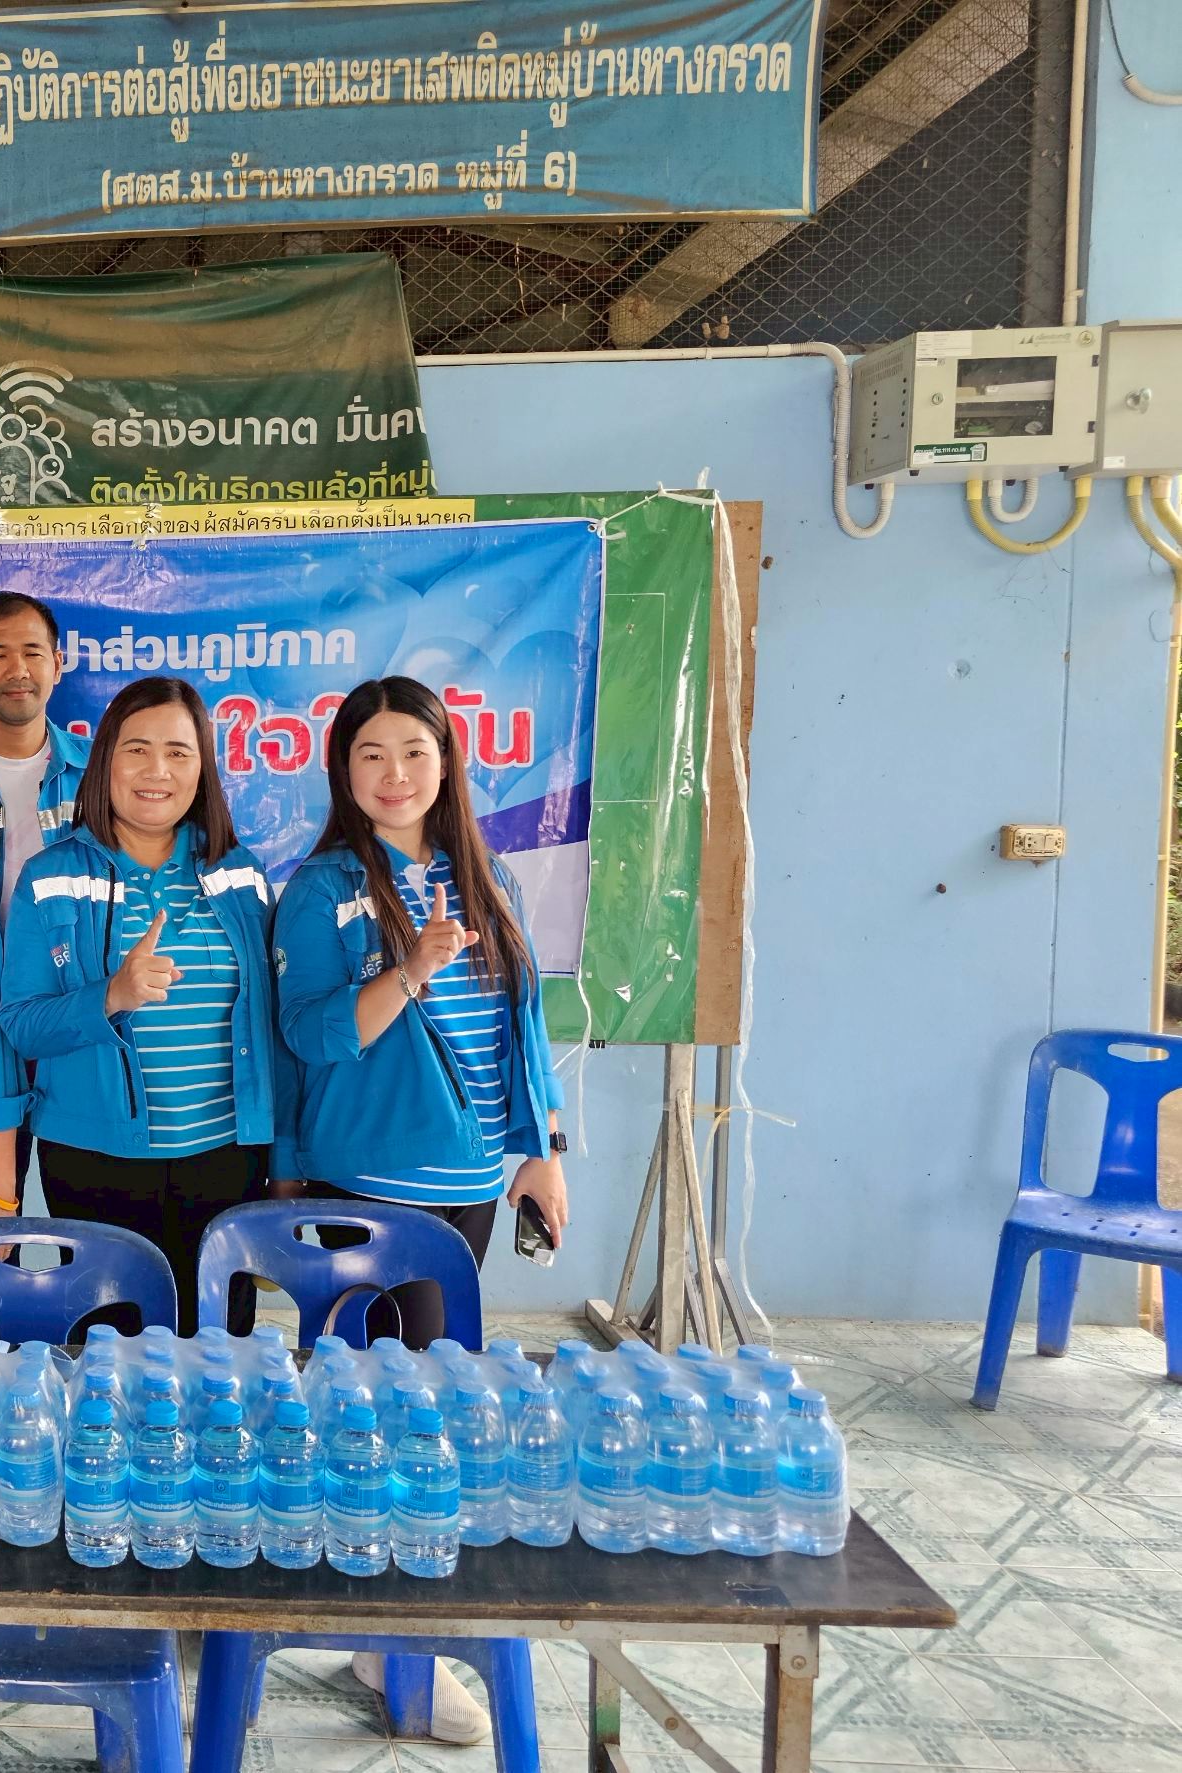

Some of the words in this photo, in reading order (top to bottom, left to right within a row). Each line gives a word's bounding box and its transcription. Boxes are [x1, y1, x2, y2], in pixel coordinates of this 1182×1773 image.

[456, 130, 528, 210] หมู่ที่
[543, 151, 577, 196] 6)
[91, 409, 317, 448] สร้างอนาคต
